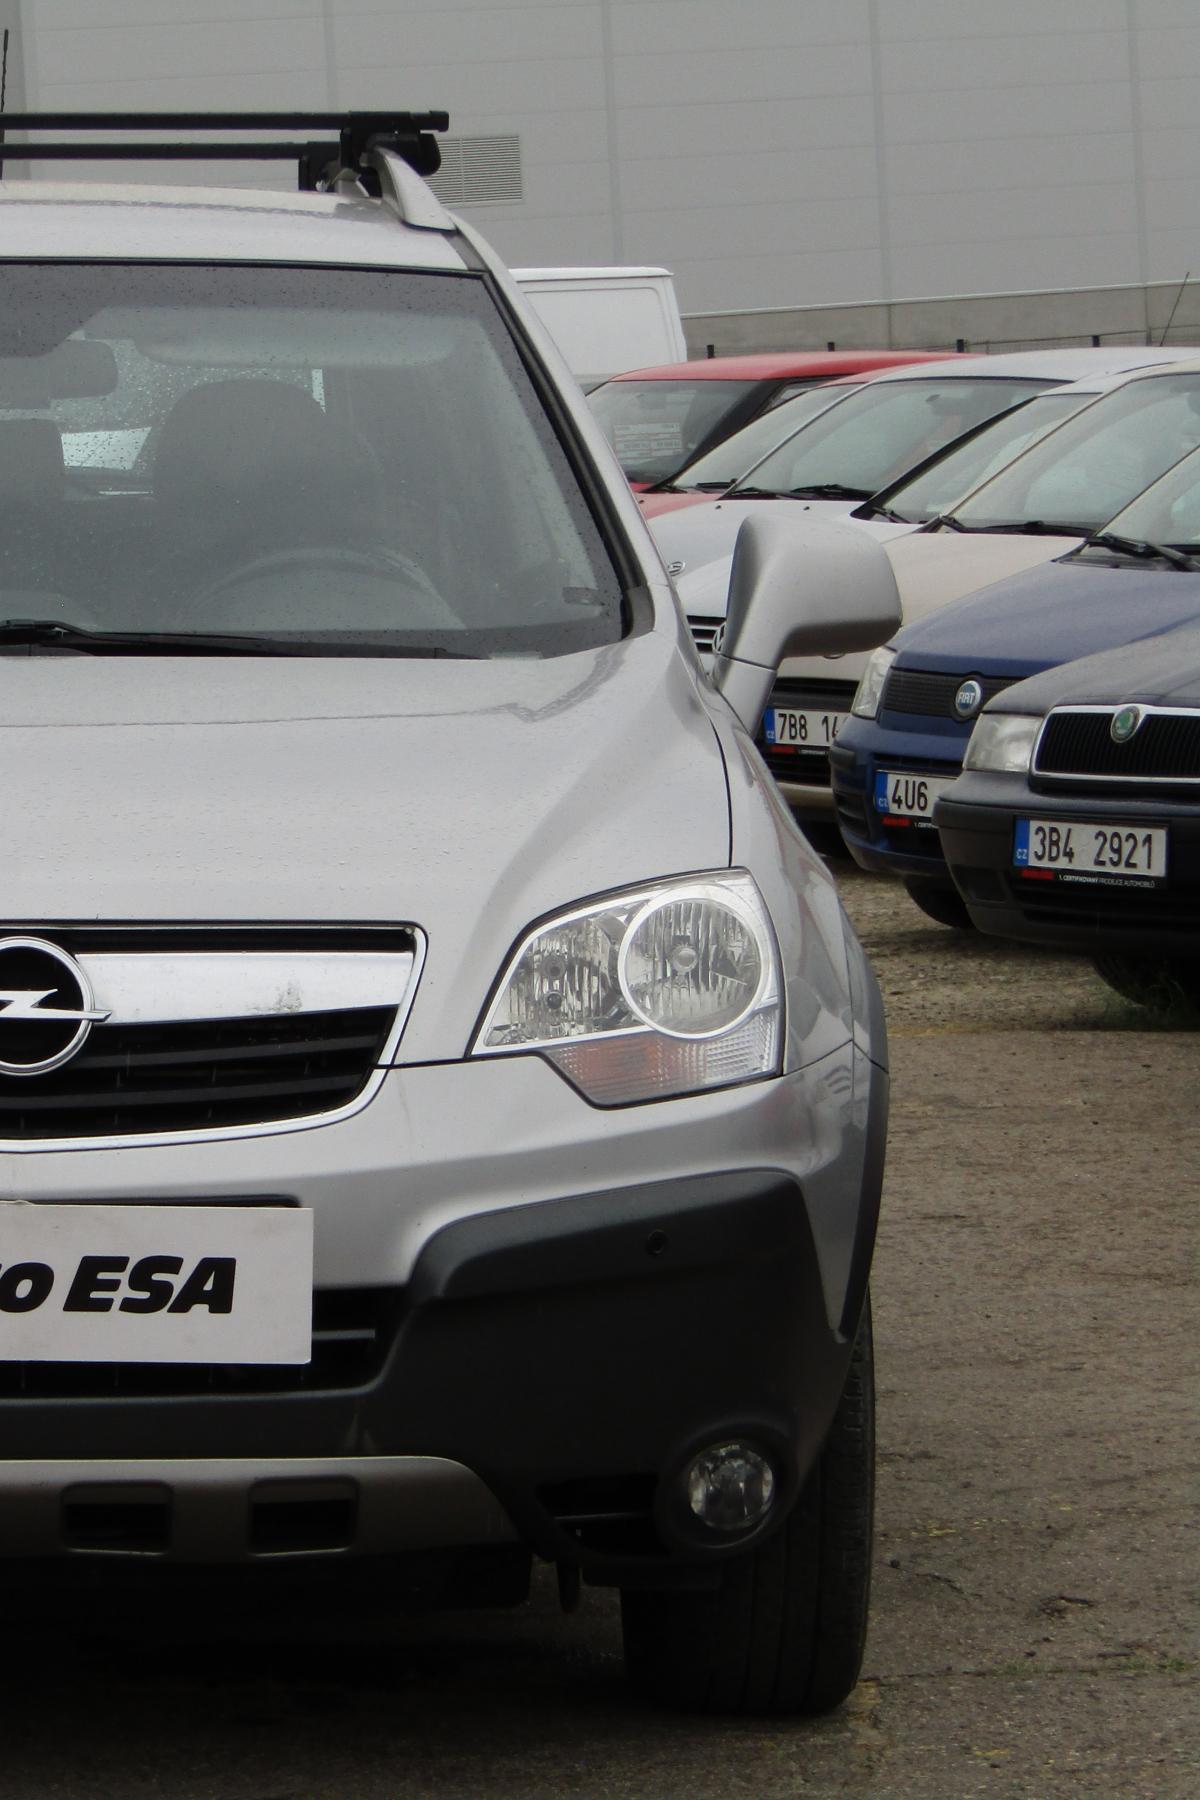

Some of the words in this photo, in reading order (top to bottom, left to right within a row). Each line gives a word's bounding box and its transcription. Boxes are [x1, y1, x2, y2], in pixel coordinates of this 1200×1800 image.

[778, 713, 808, 741] 7B8
[822, 715, 847, 743] 14
[891, 779, 928, 811] 4U6
[1016, 849, 1028, 860] CZ
[1034, 826, 1075, 864] 3B4
[1093, 830, 1153, 870] 2921
[62, 1255, 237, 1315] ESA
